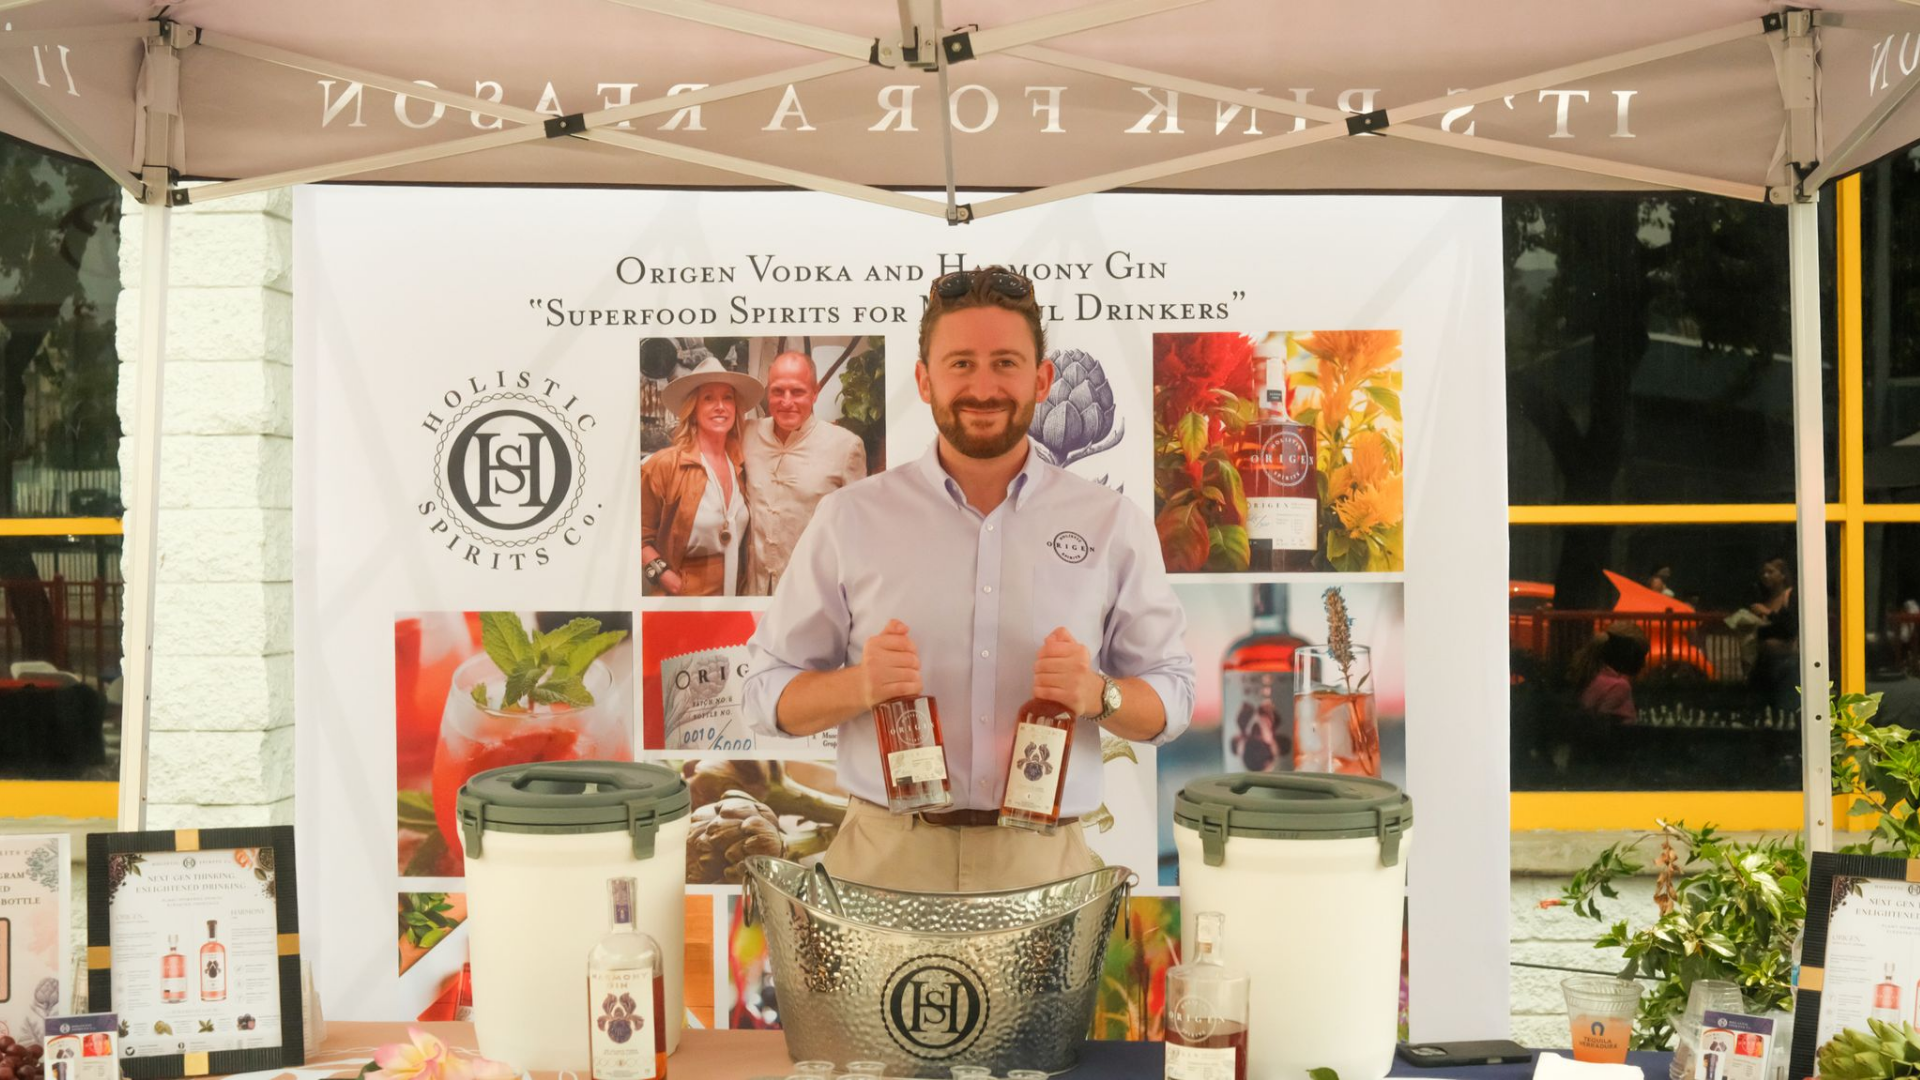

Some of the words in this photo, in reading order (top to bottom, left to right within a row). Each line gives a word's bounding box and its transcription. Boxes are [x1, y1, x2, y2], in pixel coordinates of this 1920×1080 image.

[616, 256, 737, 285] ORIGEN
[746, 253, 853, 283] VODKA
[864, 263, 924, 282] AND
[937, 252, 1094, 282] HMONY
[1105, 250, 1168, 280] GIN
[730, 295, 840, 325] SPIRITS
[853, 304, 908, 324] FOR
[421, 370, 596, 434] HOLISTIC
[1250, 454, 1314, 466] ORIGEN
[418, 500, 550, 571] SPIRITS
[1046, 540, 1095, 553] ORIGEN
[1, 897, 41, 906] BOTTLE
